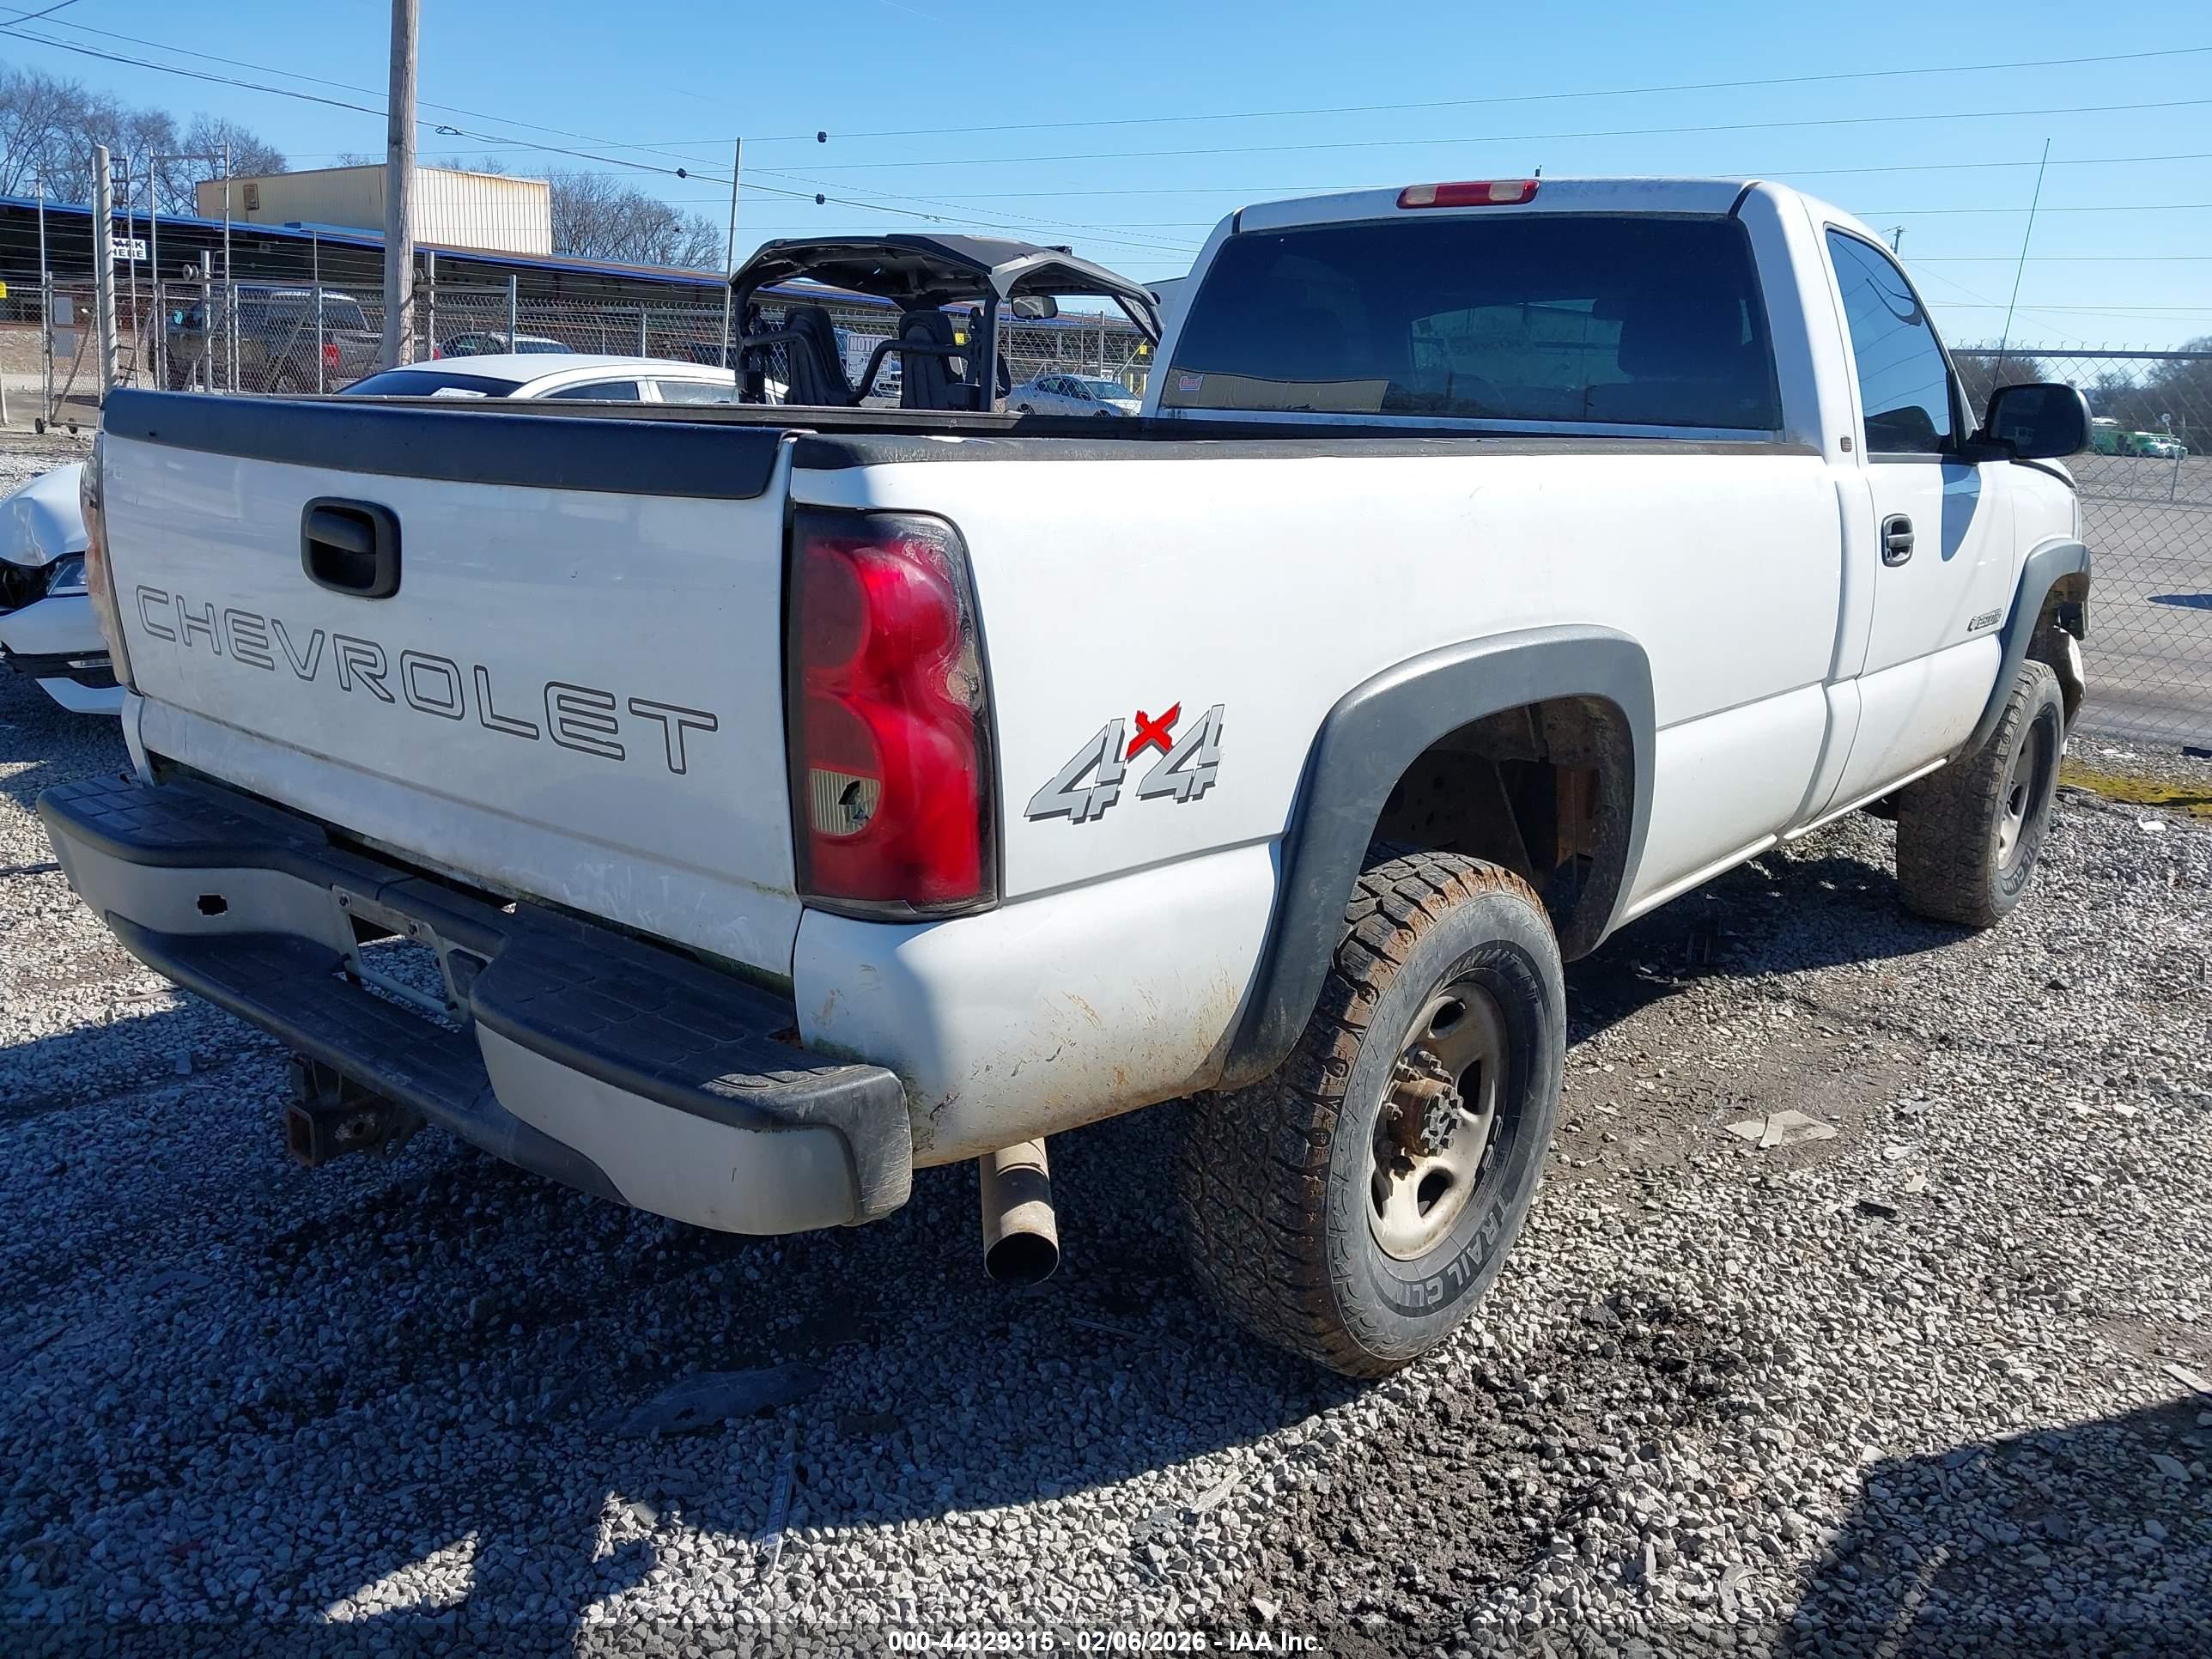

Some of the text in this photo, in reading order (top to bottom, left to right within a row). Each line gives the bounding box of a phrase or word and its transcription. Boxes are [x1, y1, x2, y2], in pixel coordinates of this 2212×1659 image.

[849, 336, 887, 352] NOTI
[137, 585, 719, 775] CHEVROLET
[1447, 1194, 1511, 1287] TRAIL
